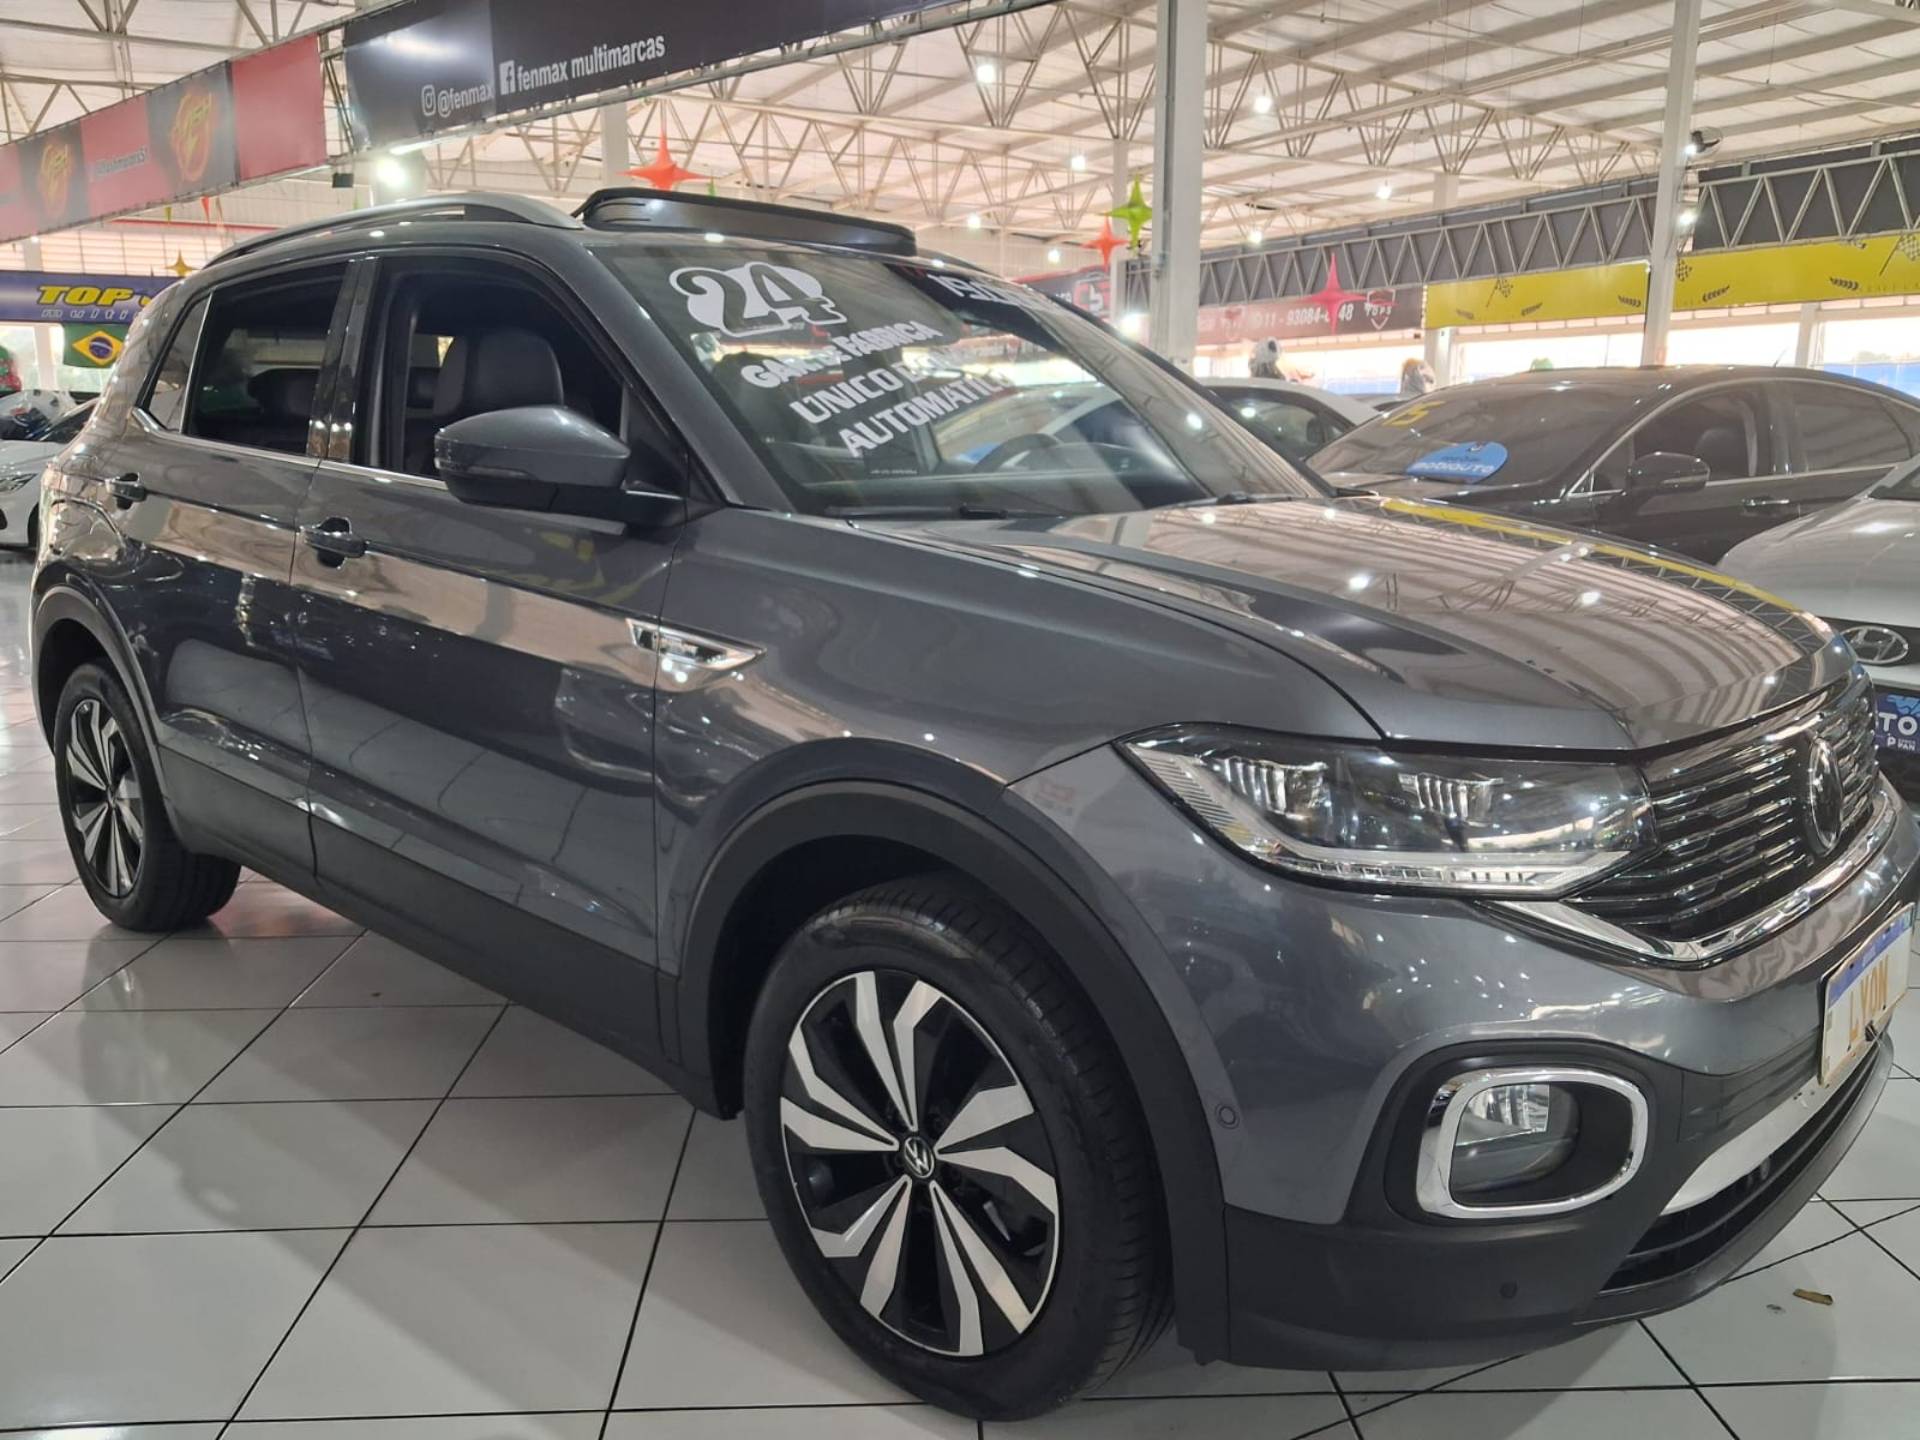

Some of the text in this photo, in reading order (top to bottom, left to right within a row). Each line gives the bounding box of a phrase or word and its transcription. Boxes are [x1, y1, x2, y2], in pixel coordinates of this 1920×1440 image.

[517, 61, 569, 92] fenmax
[571, 35, 665, 79] multimarcas
[38, 284, 134, 307] TOP
[669, 261, 848, 337] 24
